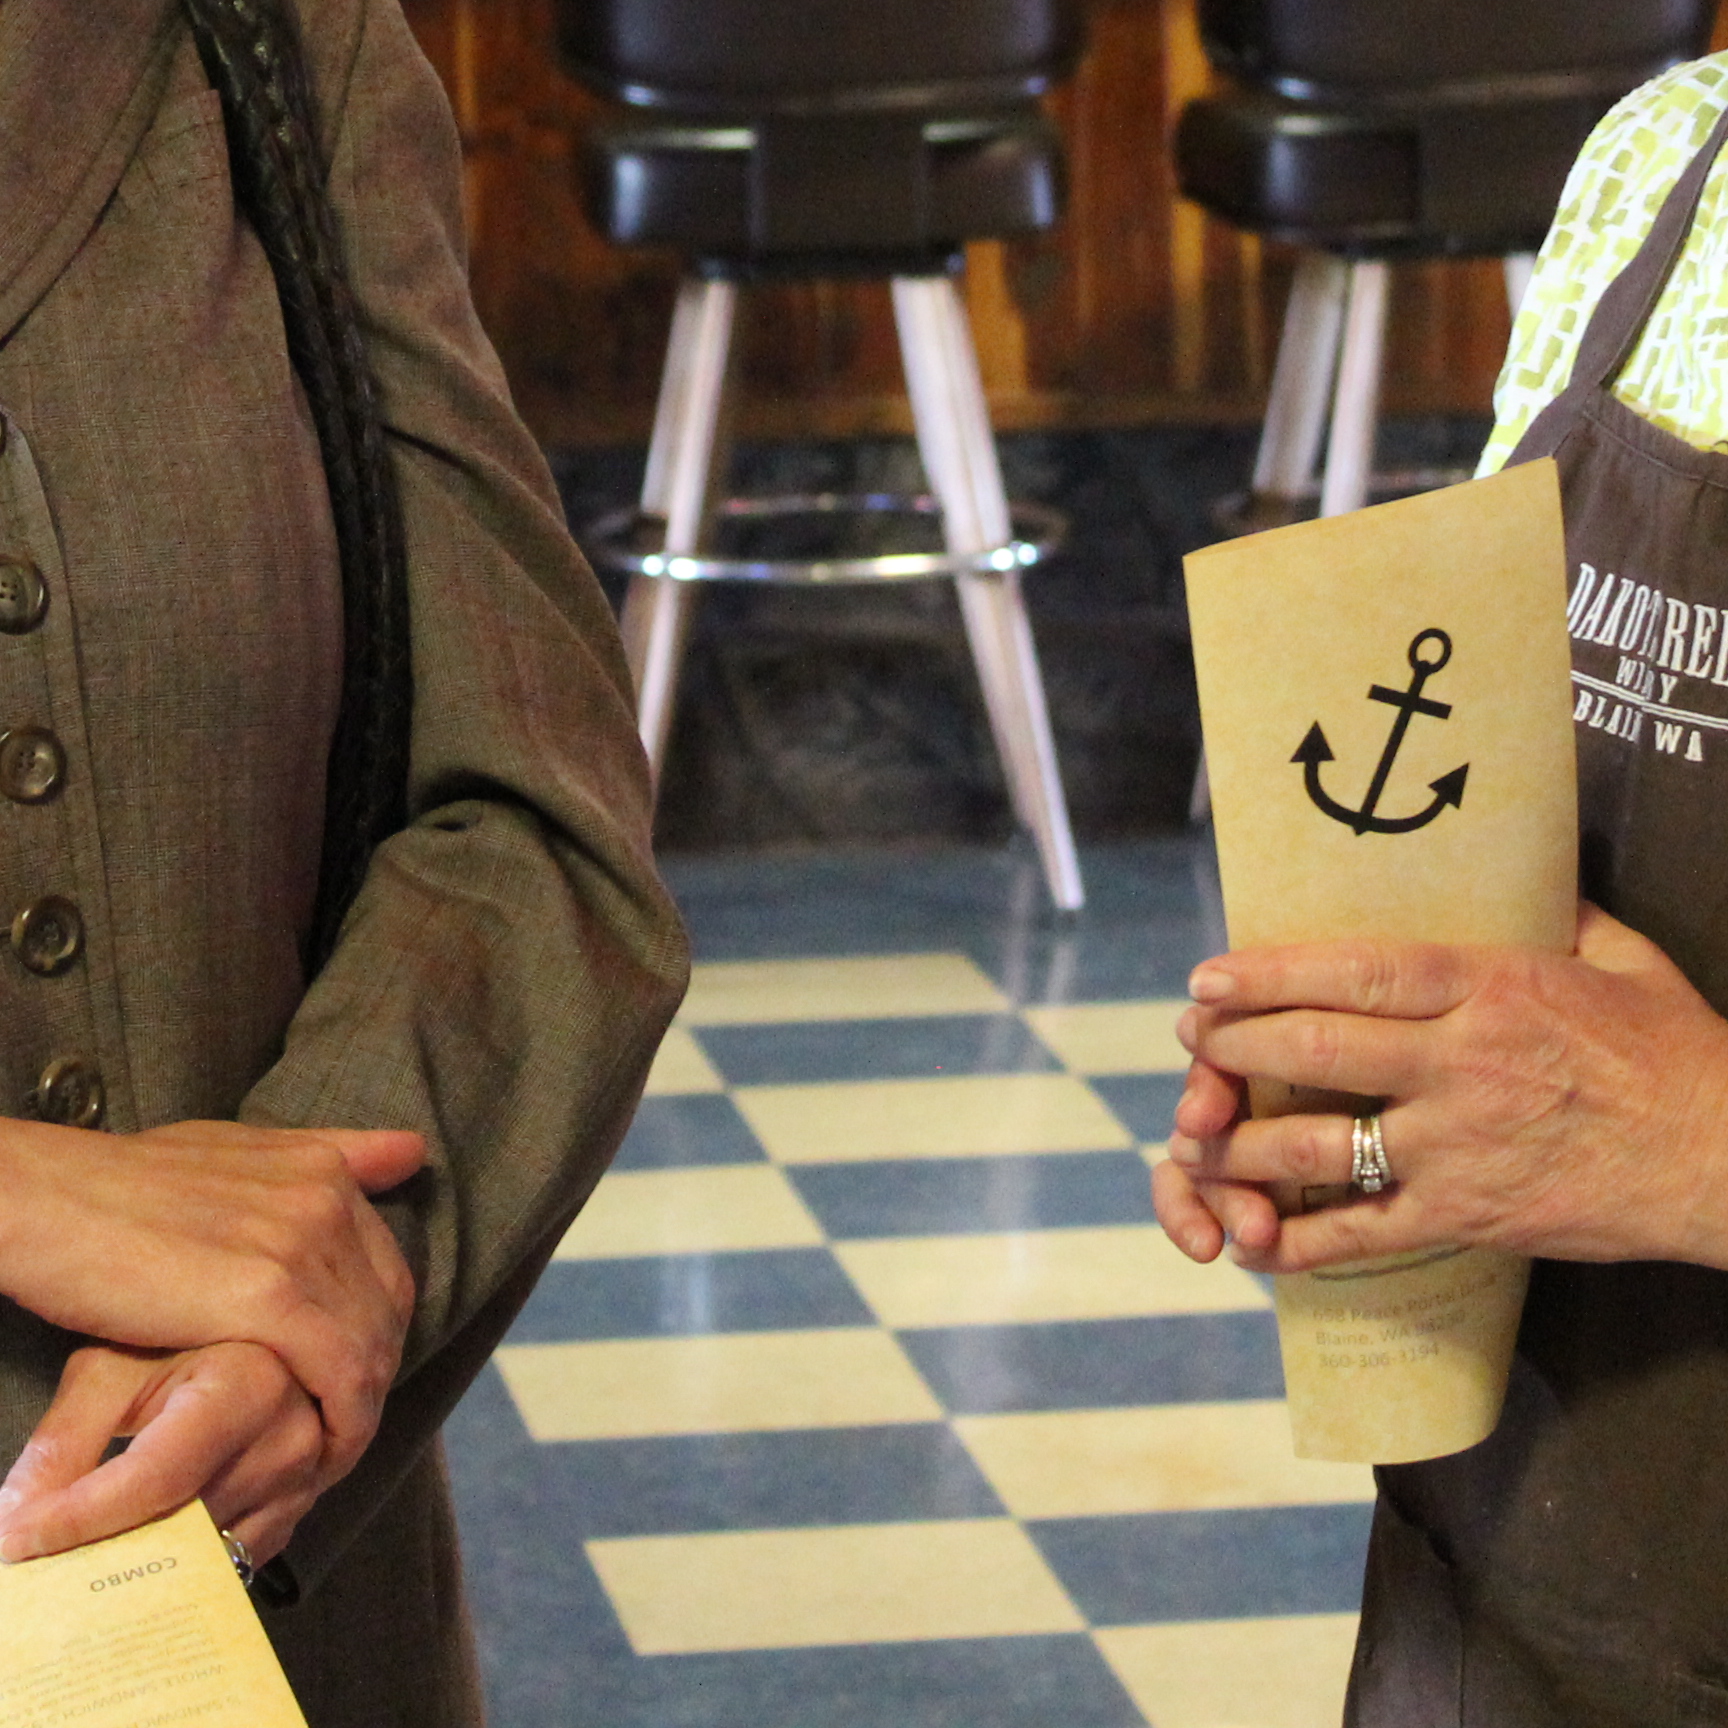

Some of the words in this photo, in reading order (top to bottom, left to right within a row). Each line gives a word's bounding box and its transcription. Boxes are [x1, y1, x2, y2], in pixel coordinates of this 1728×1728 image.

[1654, 720, 1703, 762] WA
[1351, 1305, 1401, 1322] Peace
[1407, 1290, 1455, 1313] Portal
[1316, 1330, 1374, 1346] Blaine,
[1379, 1325, 1410, 1342] WA
[90, 1557, 177, 1593] COMBO
